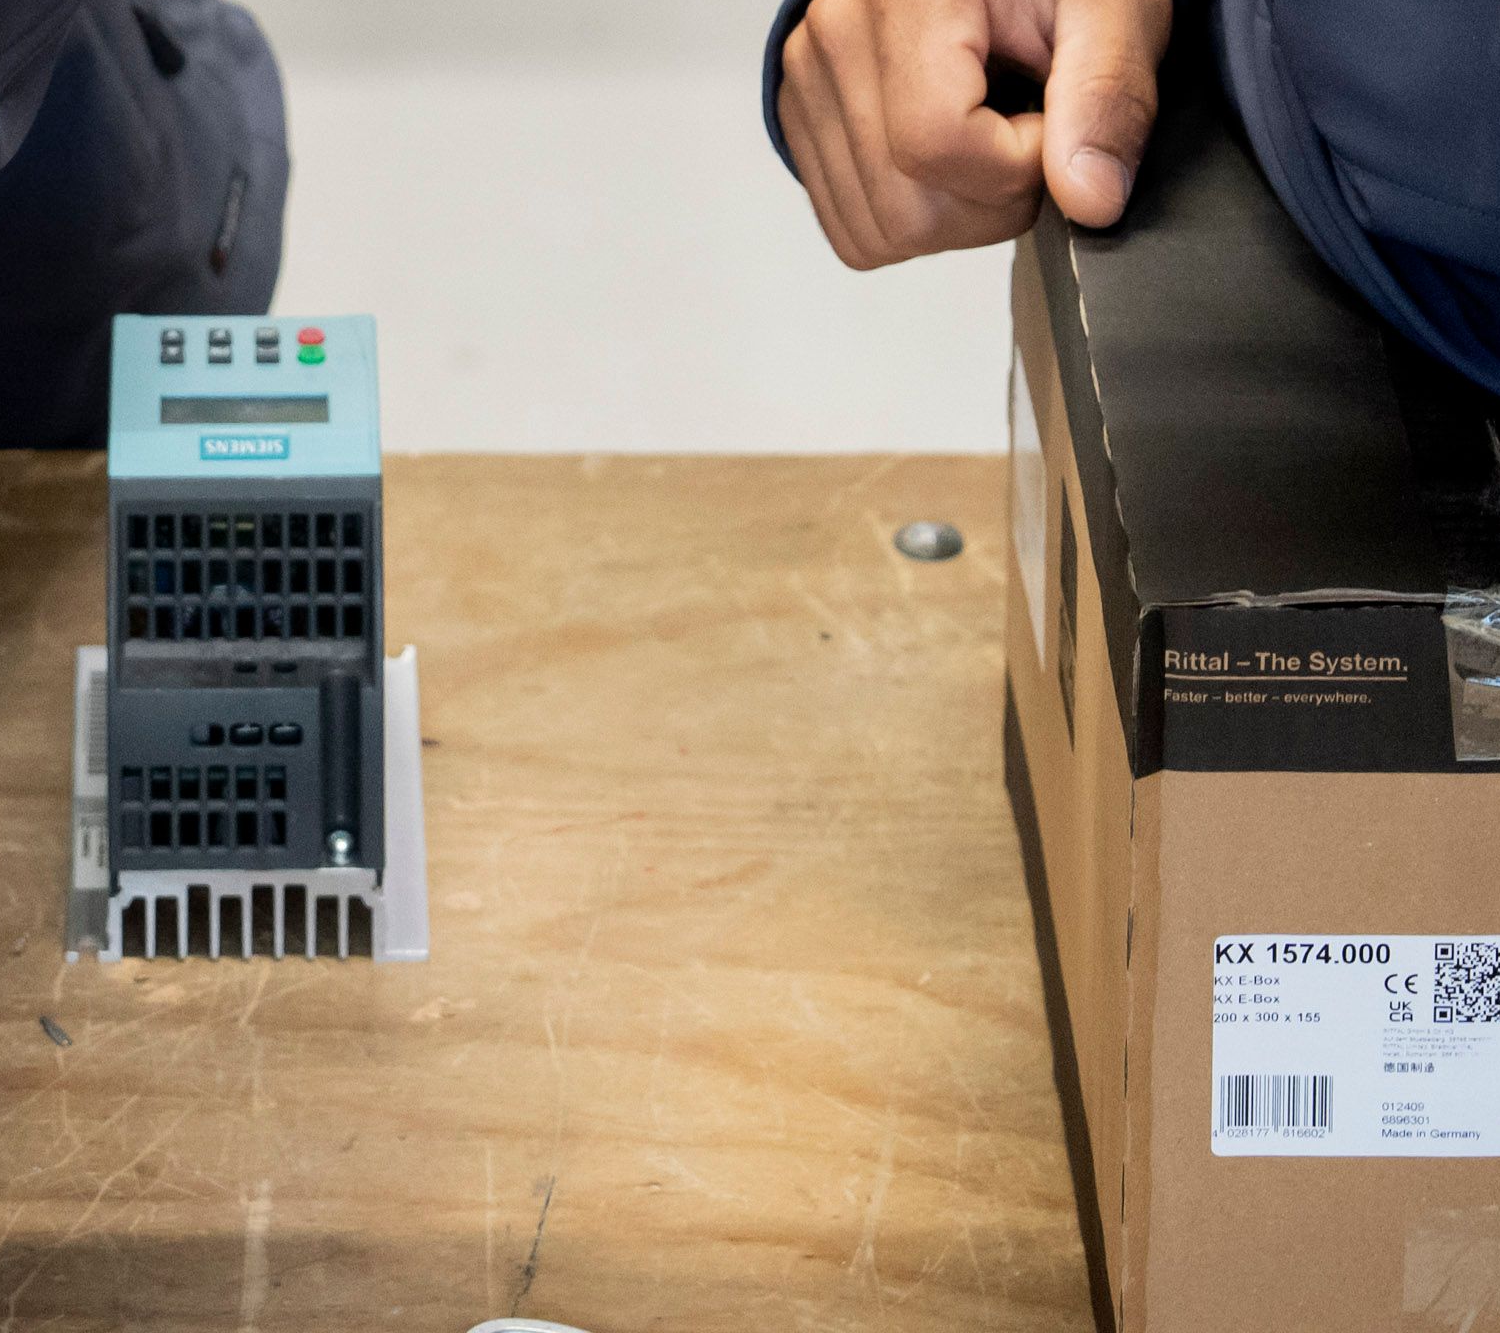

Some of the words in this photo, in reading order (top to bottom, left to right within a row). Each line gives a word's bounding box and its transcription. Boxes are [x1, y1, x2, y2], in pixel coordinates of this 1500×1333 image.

[204, 439, 284, 454] SIEMENS
[1165, 649, 1229, 671] Rittal
[1255, 651, 1301, 671] The
[1308, 651, 1408, 675] System.
[1164, 689, 1208, 703] Faster
[1225, 690, 1267, 703] better
[1284, 690, 1372, 706] everywhere.
[1215, 943, 1254, 964] KX
[1266, 943, 1391, 964] 1574.000
[1214, 976, 1233, 986] KX
[1238, 975, 1280, 986] E-Box
[1214, 994, 1233, 1004] KX
[1238, 993, 1280, 1004] E-Box
[1389, 1001, 1412, 1011] UK
[1214, 1012, 1237, 1023] 200
[1242, 1014, 1249, 1022] x
[1255, 1012, 1279, 1022] 300
[1284, 1014, 1291, 1022] x
[1298, 1012, 1321, 1023] 155
[1381, 1102, 1425, 1111] 012409
[1381, 1116, 1430, 1125] 6896301
[1227, 1129, 1270, 1138] 028177
[1282, 1129, 1326, 1138] 816602
[1381, 1129, 1412, 1138] Made
[1416, 1130, 1426, 1138] in
[1430, 1129, 1481, 1140] Germany
